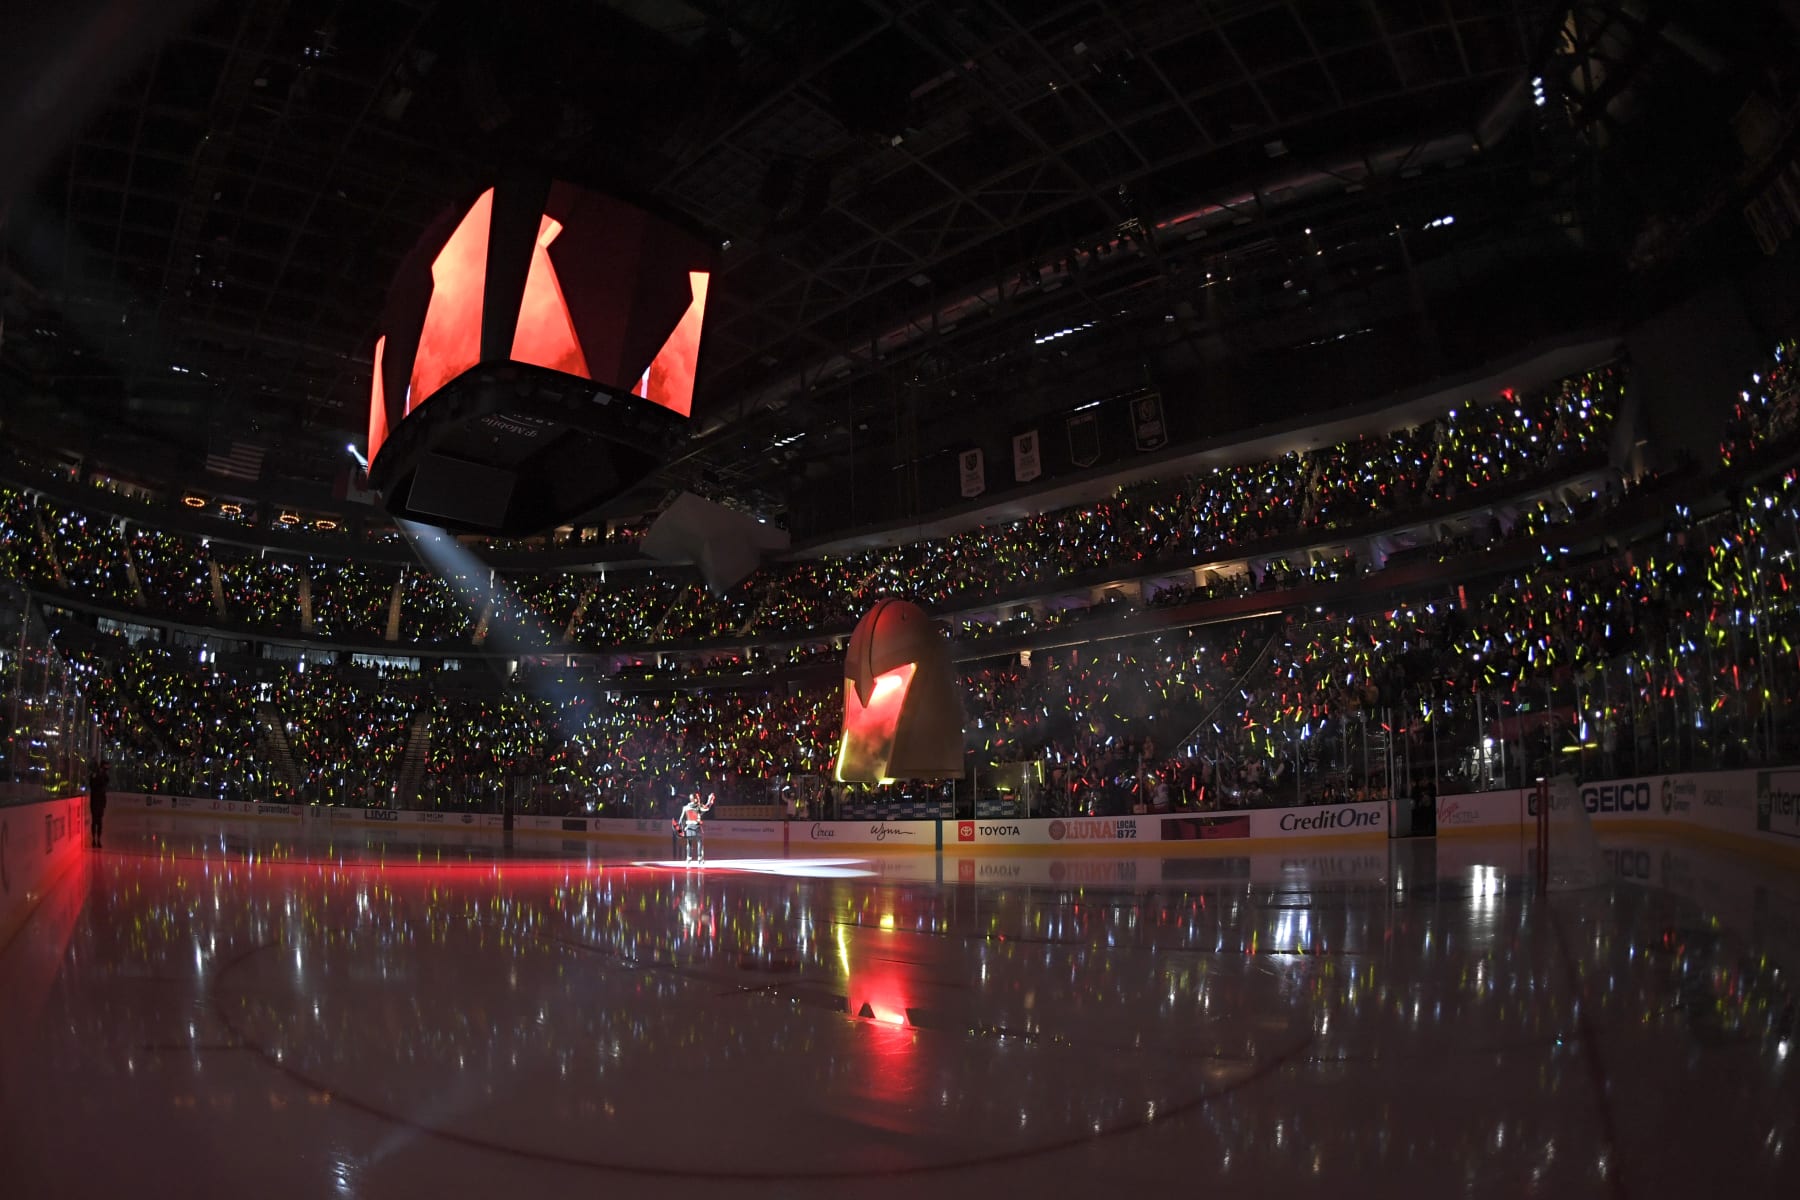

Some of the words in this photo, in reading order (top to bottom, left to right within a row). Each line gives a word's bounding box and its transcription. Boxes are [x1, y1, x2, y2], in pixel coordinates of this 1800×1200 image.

[1583, 783, 1650, 813] GEICO
[1117, 821, 1137, 829] LOCAL
[1280, 808, 1381, 831] CreditOne
[811, 823, 835, 840] Circa
[870, 823, 916, 841] Wynn
[979, 826, 1020, 836] TOYOTA
[1117, 830, 1137, 838] 872
